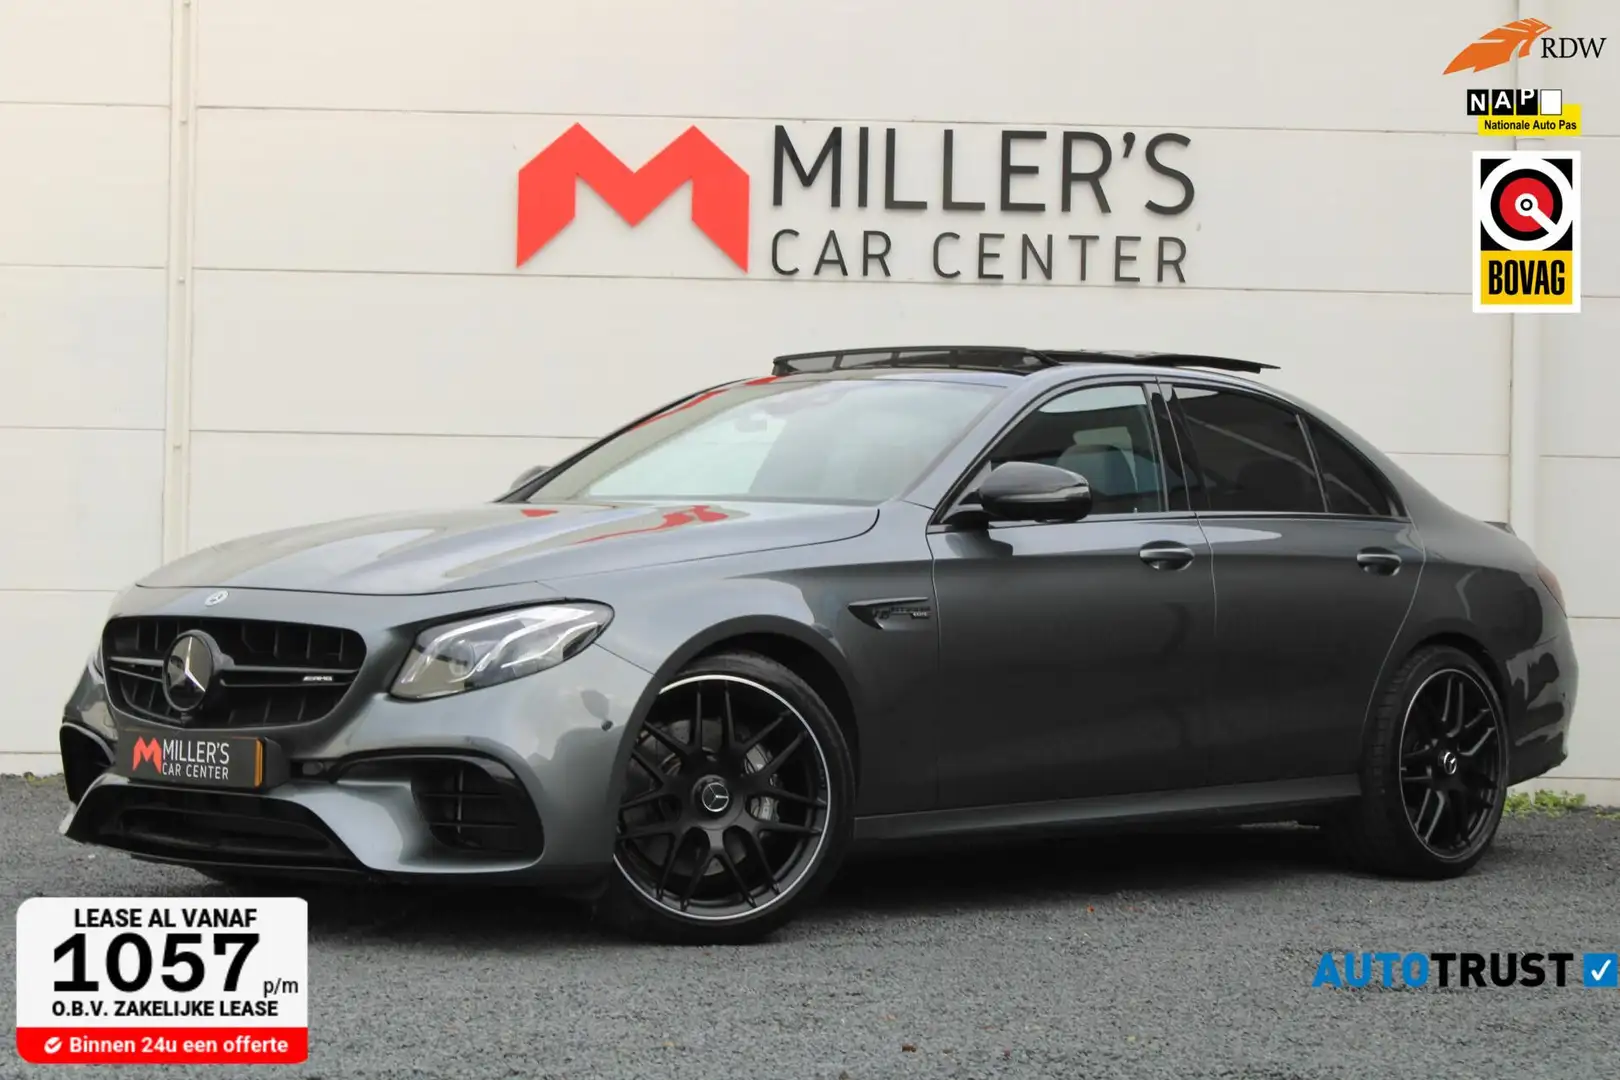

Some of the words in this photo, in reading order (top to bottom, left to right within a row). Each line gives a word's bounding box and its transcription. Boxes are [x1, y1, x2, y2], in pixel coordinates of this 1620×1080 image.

[772, 125, 1195, 216] MILLER'S
[771, 228, 893, 277] CAR
[933, 231, 1188, 284] CENTER
[162, 738, 230, 765] MILLER'S
[162, 762, 181, 777] CAR
[186, 764, 229, 780] CENTER
